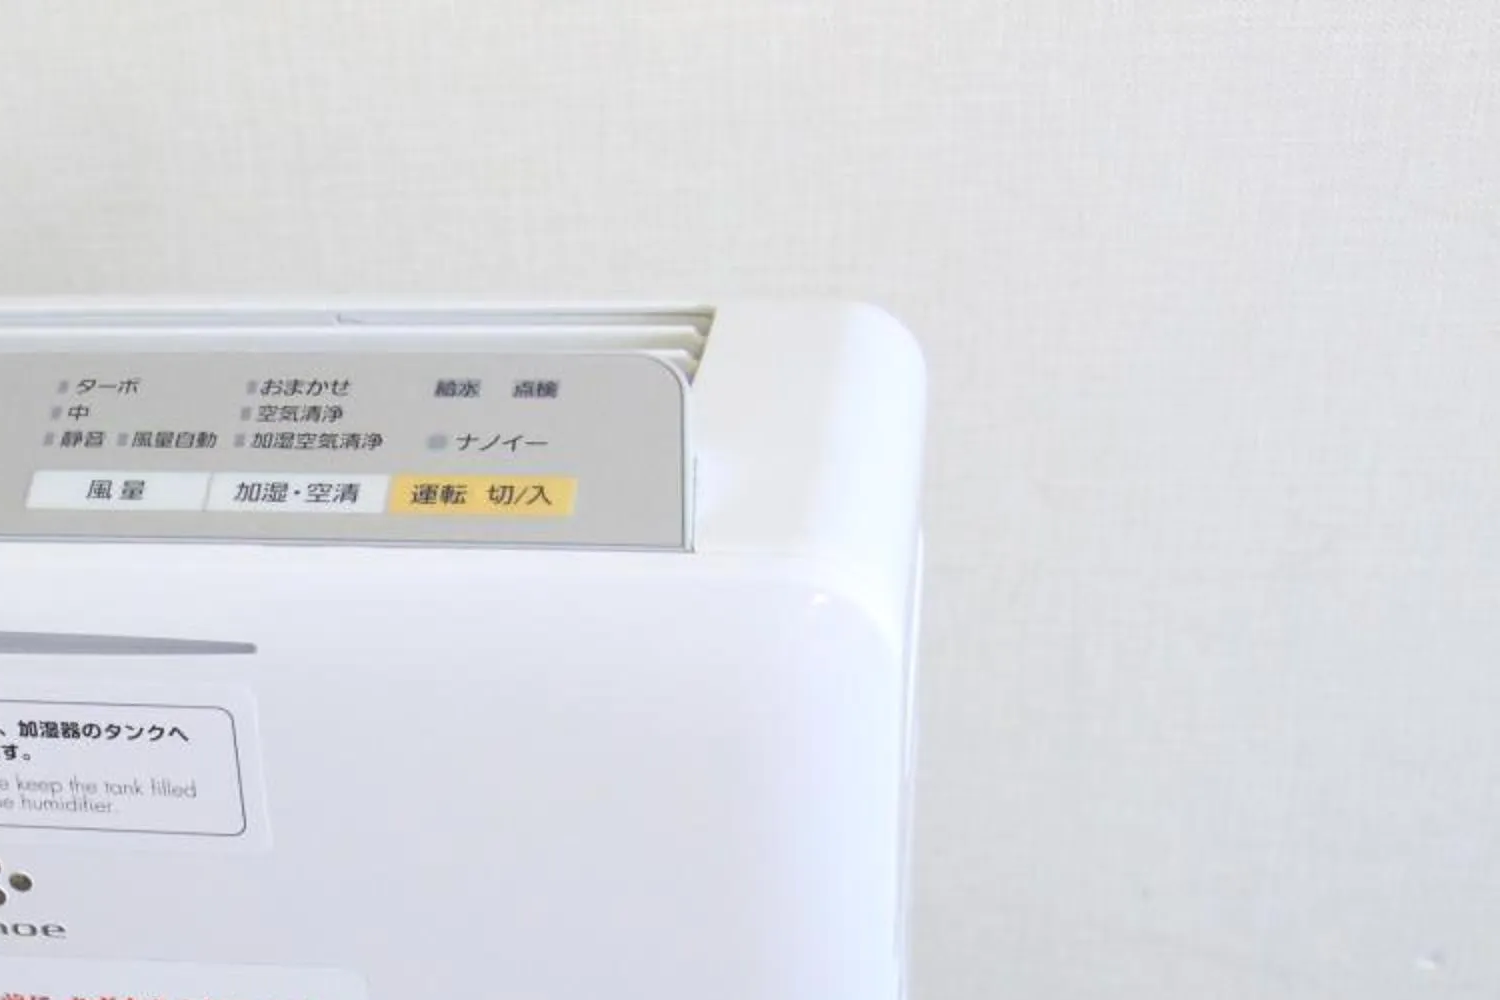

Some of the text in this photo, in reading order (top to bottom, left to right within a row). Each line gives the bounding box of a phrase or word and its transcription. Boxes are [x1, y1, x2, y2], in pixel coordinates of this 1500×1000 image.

[75, 378, 141, 395] ターボ
[259, 378, 350, 396] おまかせ
[68, 405, 90, 422] 中
[256, 405, 344, 422] 空気清浄
[59, 431, 105, 449] 静音
[131, 431, 218, 449] 風量自動
[249, 432, 383, 450] 加湿空気清浄
[456, 434, 549, 452] ナノイー
[409, 484, 467, 505] 運転
[17, 776, 63, 796] keep
[70, 776, 97, 795] the
[103, 779, 144, 797] tank
[150, 779, 197, 798] filled
